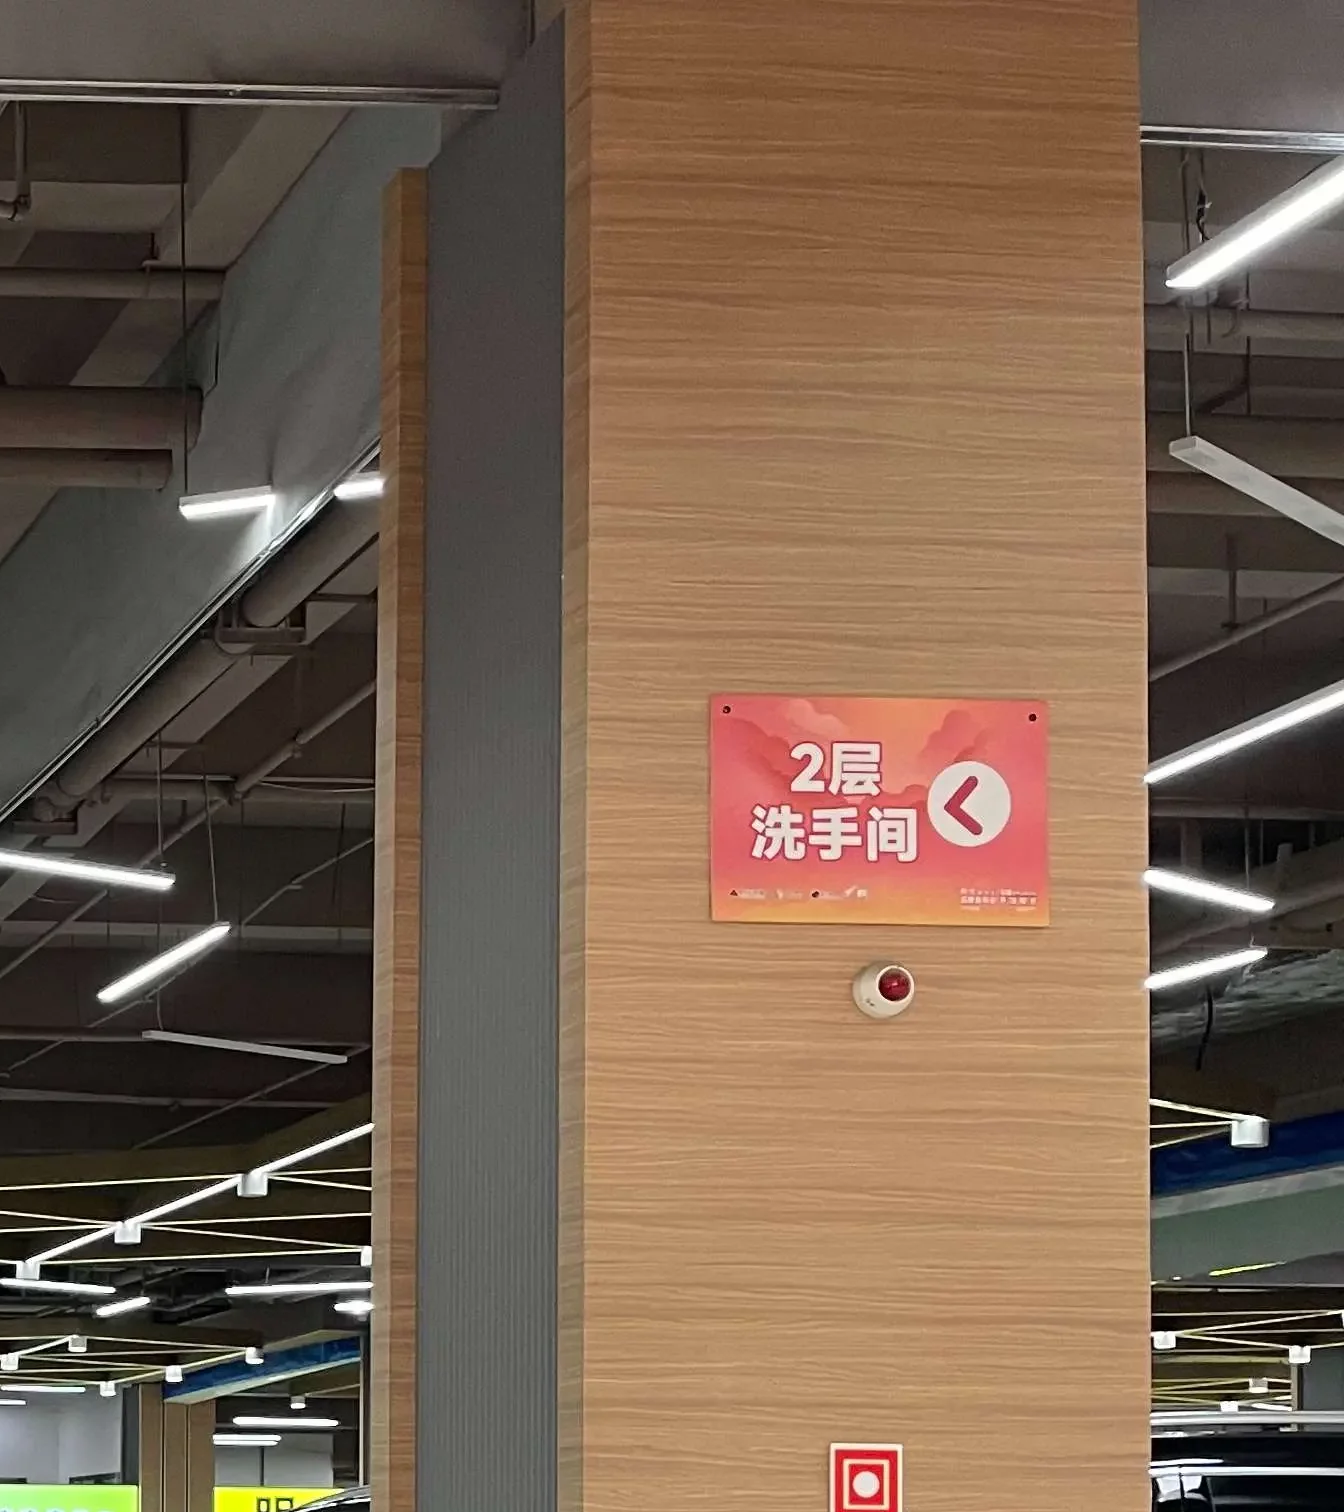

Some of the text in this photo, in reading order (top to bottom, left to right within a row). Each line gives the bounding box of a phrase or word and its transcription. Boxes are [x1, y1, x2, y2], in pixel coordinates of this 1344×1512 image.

[790, 741, 882, 797] 2层
[750, 804, 919, 863] 洗手间
